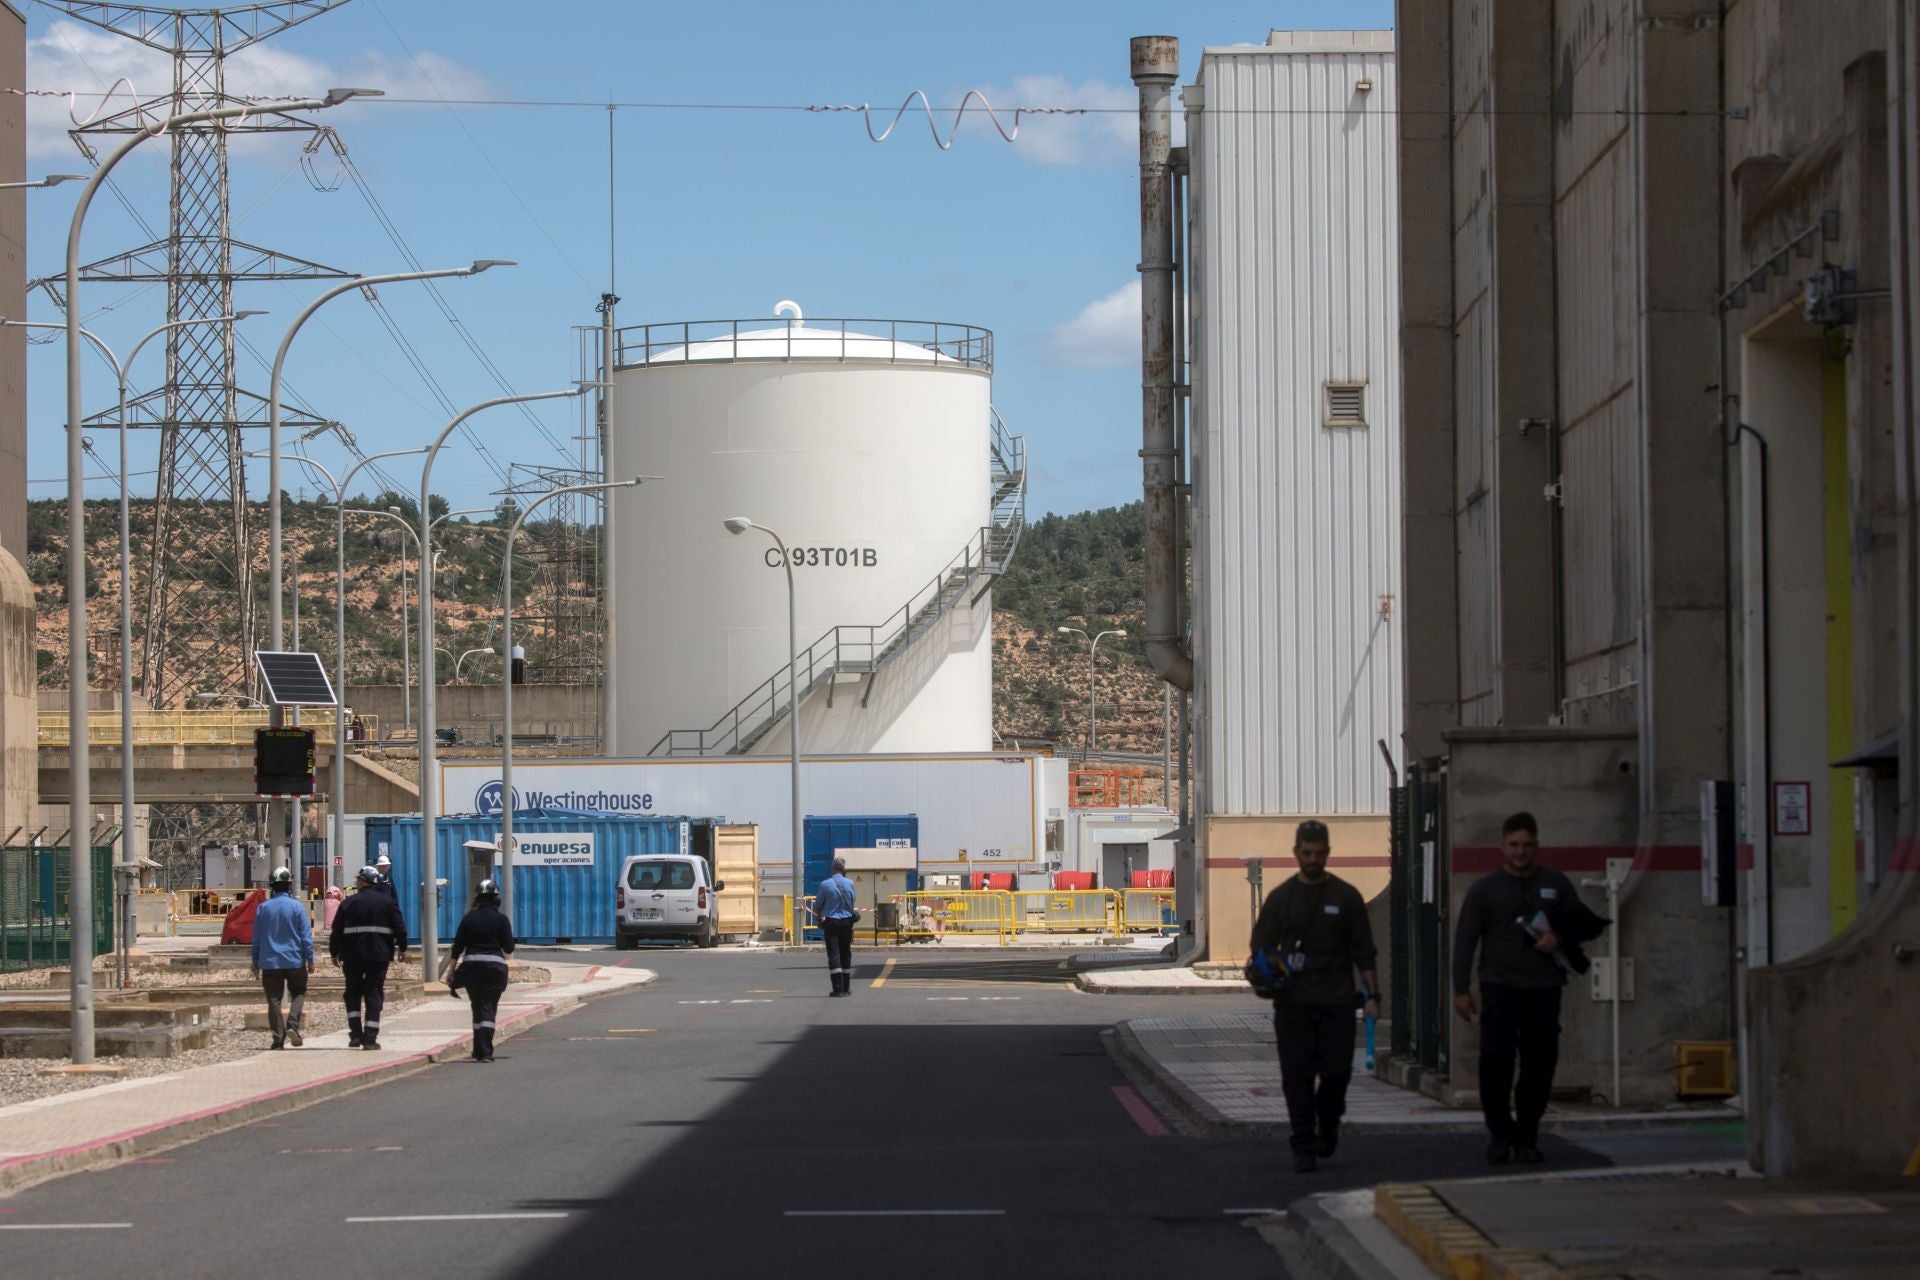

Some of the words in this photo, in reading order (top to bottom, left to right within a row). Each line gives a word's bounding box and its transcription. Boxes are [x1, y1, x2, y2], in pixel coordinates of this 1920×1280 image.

[526, 790, 653, 812] Westinghouse
[520, 843, 590, 854] enwesa
[983, 849, 1001, 857] 452
